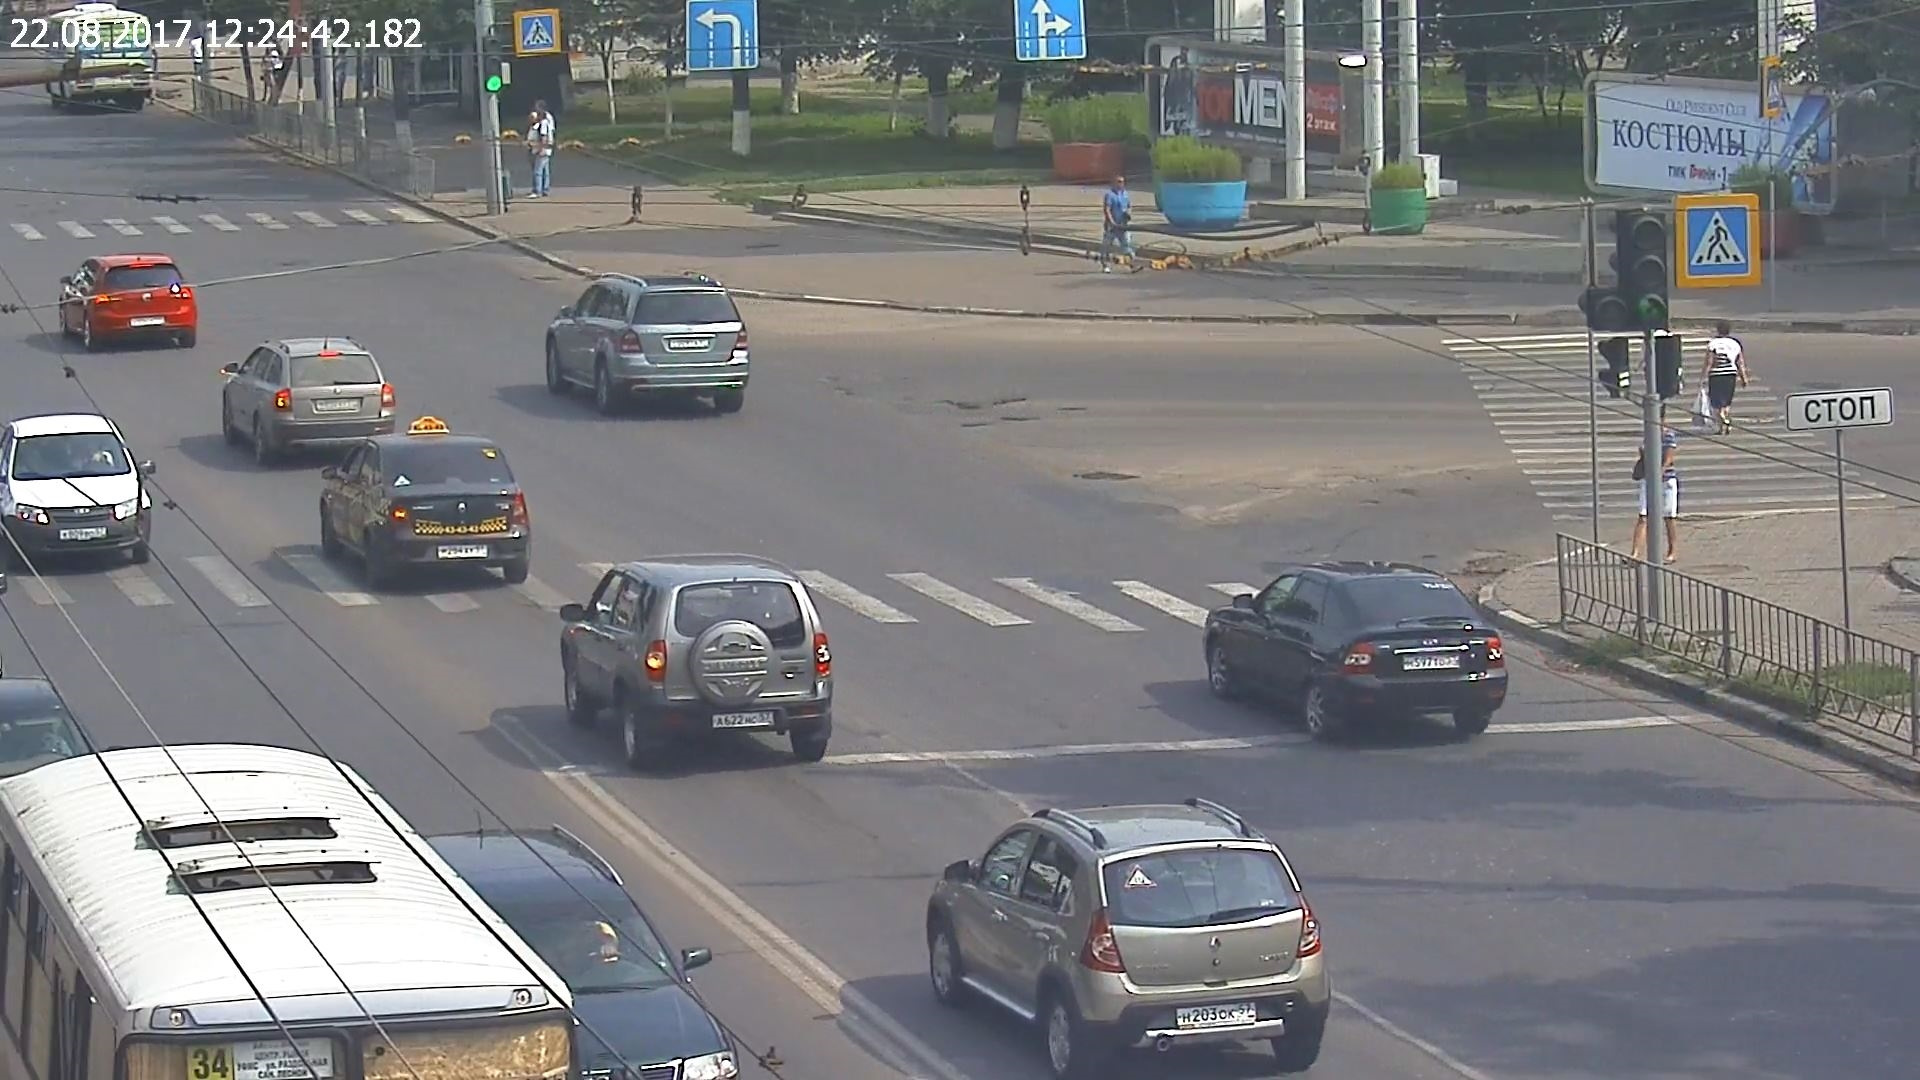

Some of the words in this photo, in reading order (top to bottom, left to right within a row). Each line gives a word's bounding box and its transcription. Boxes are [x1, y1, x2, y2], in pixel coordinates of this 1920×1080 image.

[1612, 119, 1748, 157] КОСТЮМЫ
[1805, 396, 1875, 423] СТОП
[193, 1049, 228, 1079] 34
